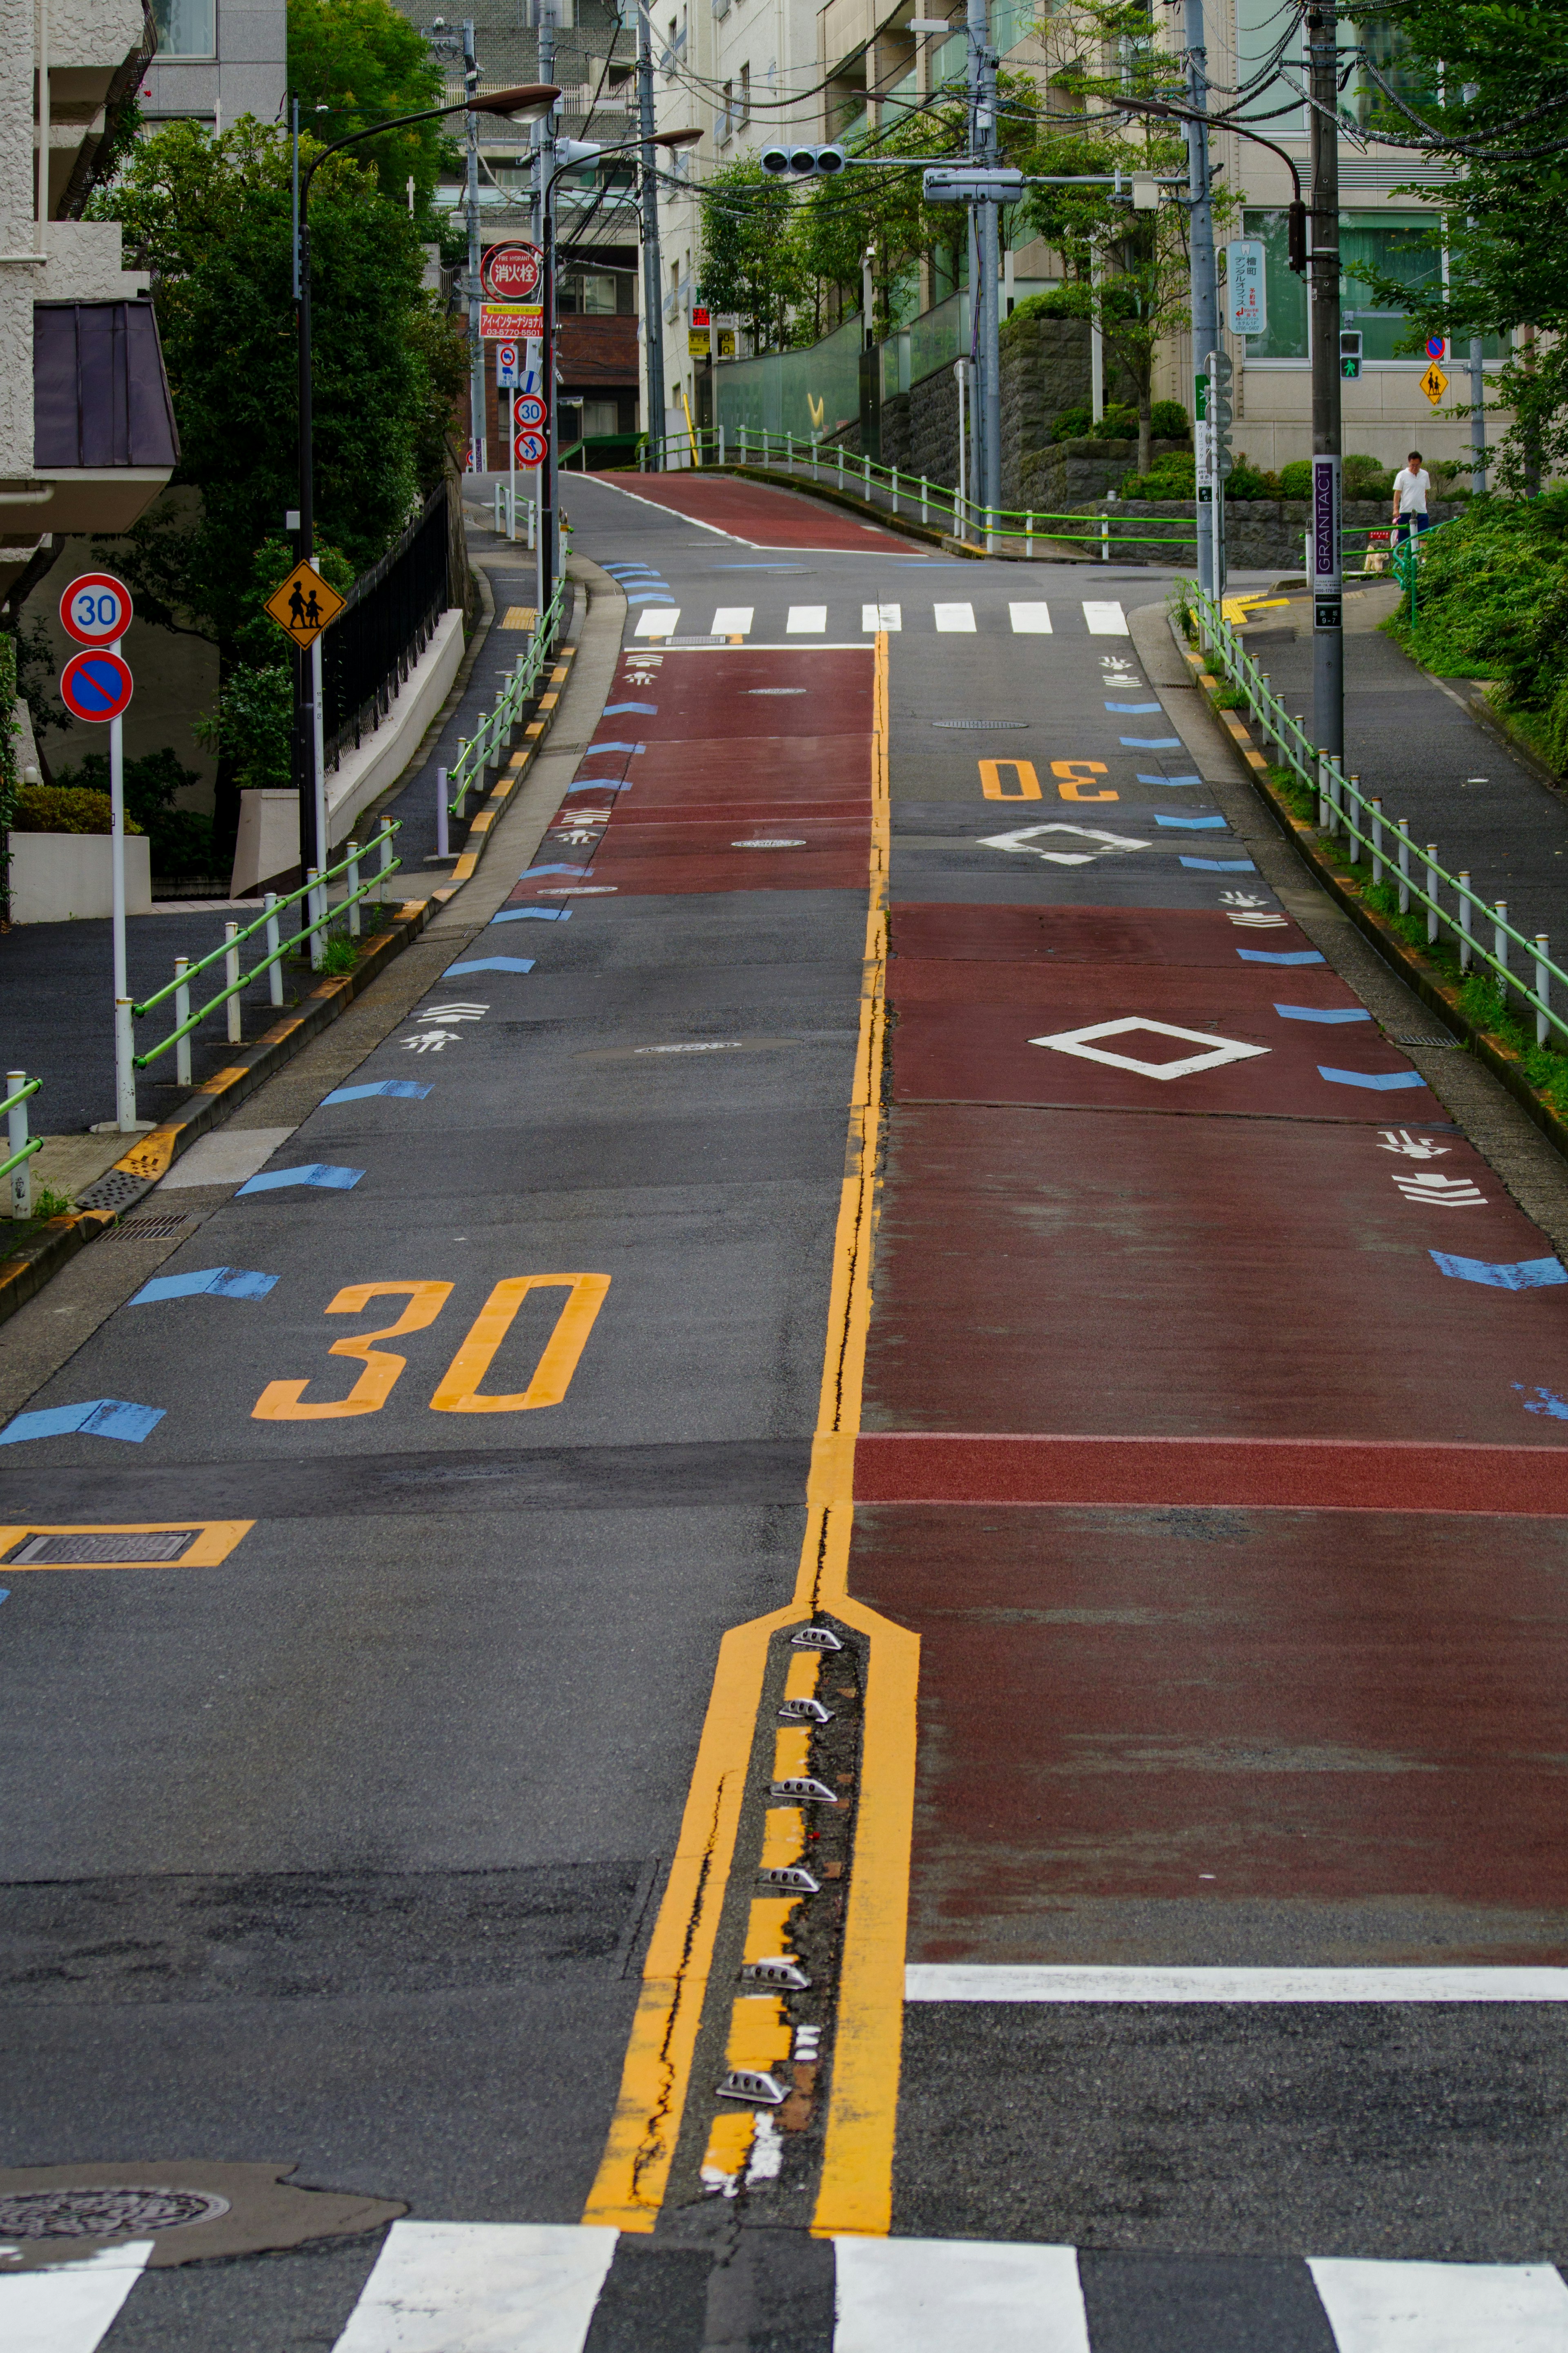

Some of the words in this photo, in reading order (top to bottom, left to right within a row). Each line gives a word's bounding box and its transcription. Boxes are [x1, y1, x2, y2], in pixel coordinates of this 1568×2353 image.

[495, 264, 535, 282] 消火栓
[1235, 257, 1245, 306] デンタルオフィス
[1246, 257, 1257, 275] 檜町
[482, 315, 543, 328] アイ・インターナショナル
[522, 404, 539, 419] 30
[1318, 467, 1330, 571] GRANTACT
[78, 595, 116, 626] 30
[978, 759, 1120, 801] 30
[250, 1272, 612, 1420] 30
